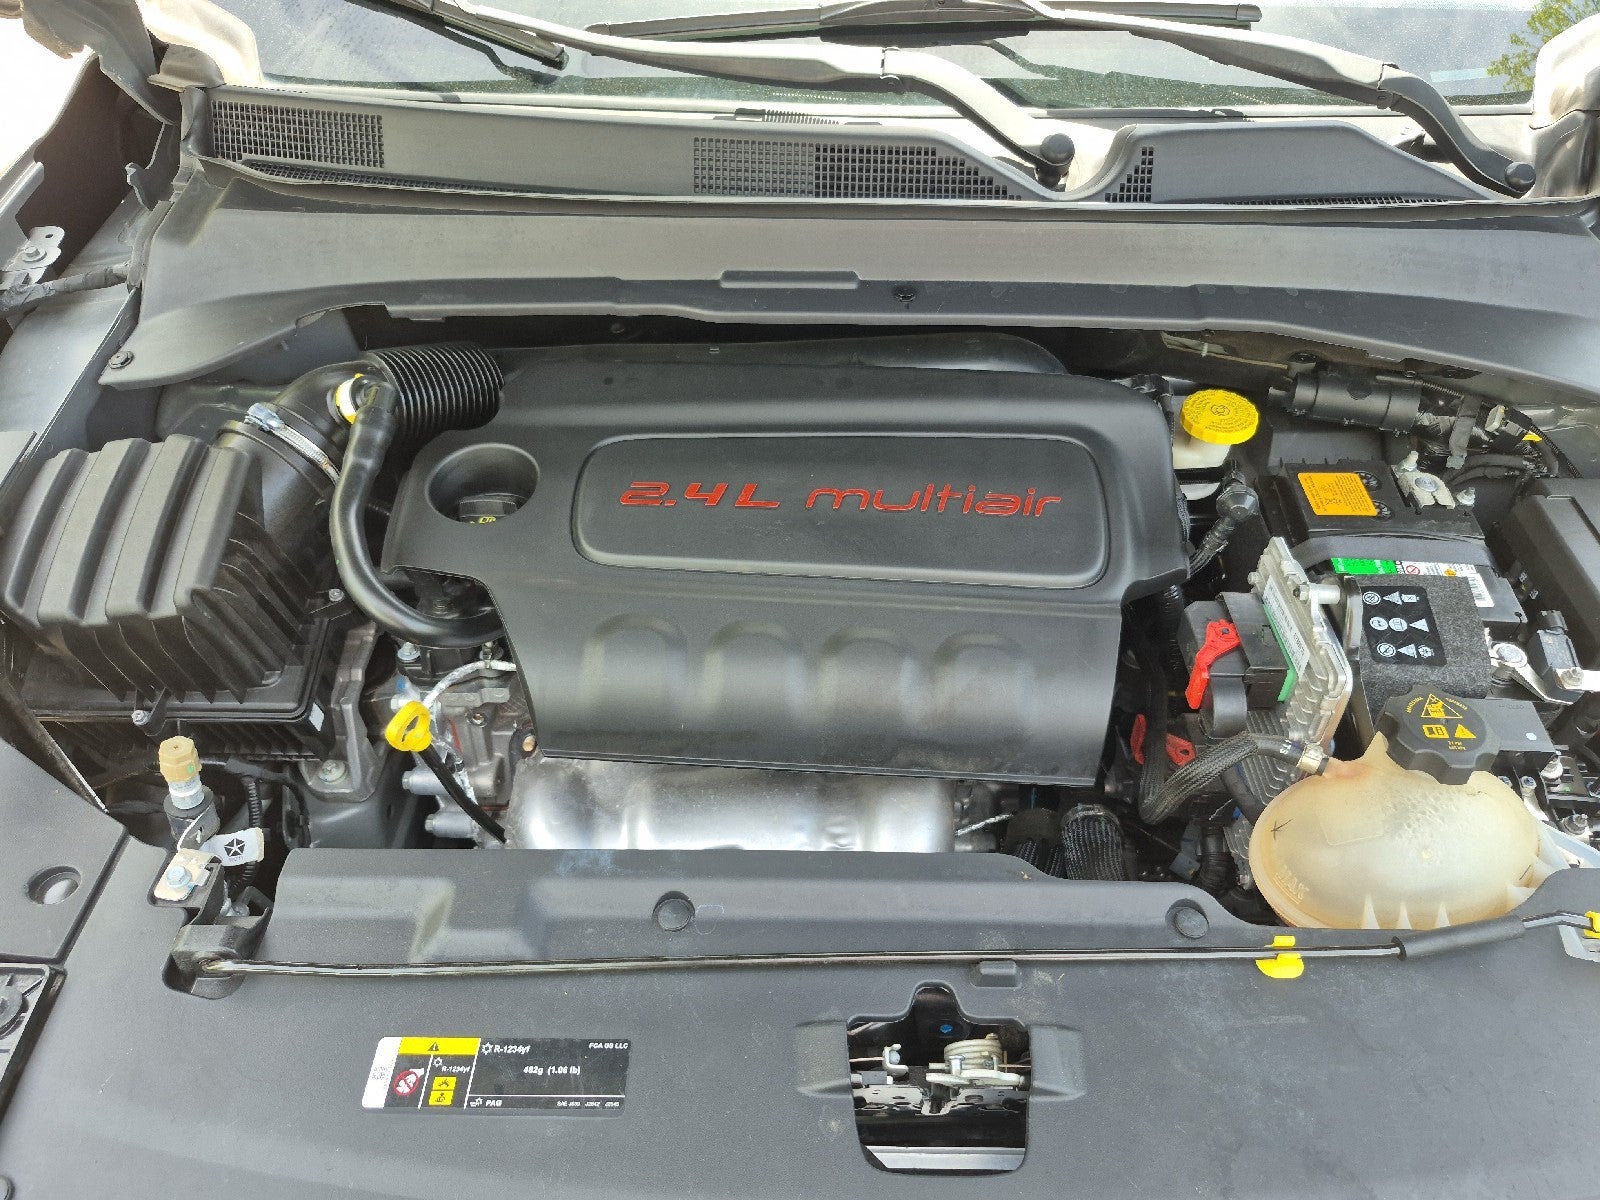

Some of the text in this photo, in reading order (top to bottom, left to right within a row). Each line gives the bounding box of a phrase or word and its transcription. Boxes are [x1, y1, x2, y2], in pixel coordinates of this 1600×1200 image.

[805, 484, 1062, 516] multiair
[493, 1044, 531, 1055] R-1234yf
[441, 1065, 471, 1074] R-1234yf
[569, 1065, 581, 1076] lb)
[485, 1099, 503, 1107] PAG
